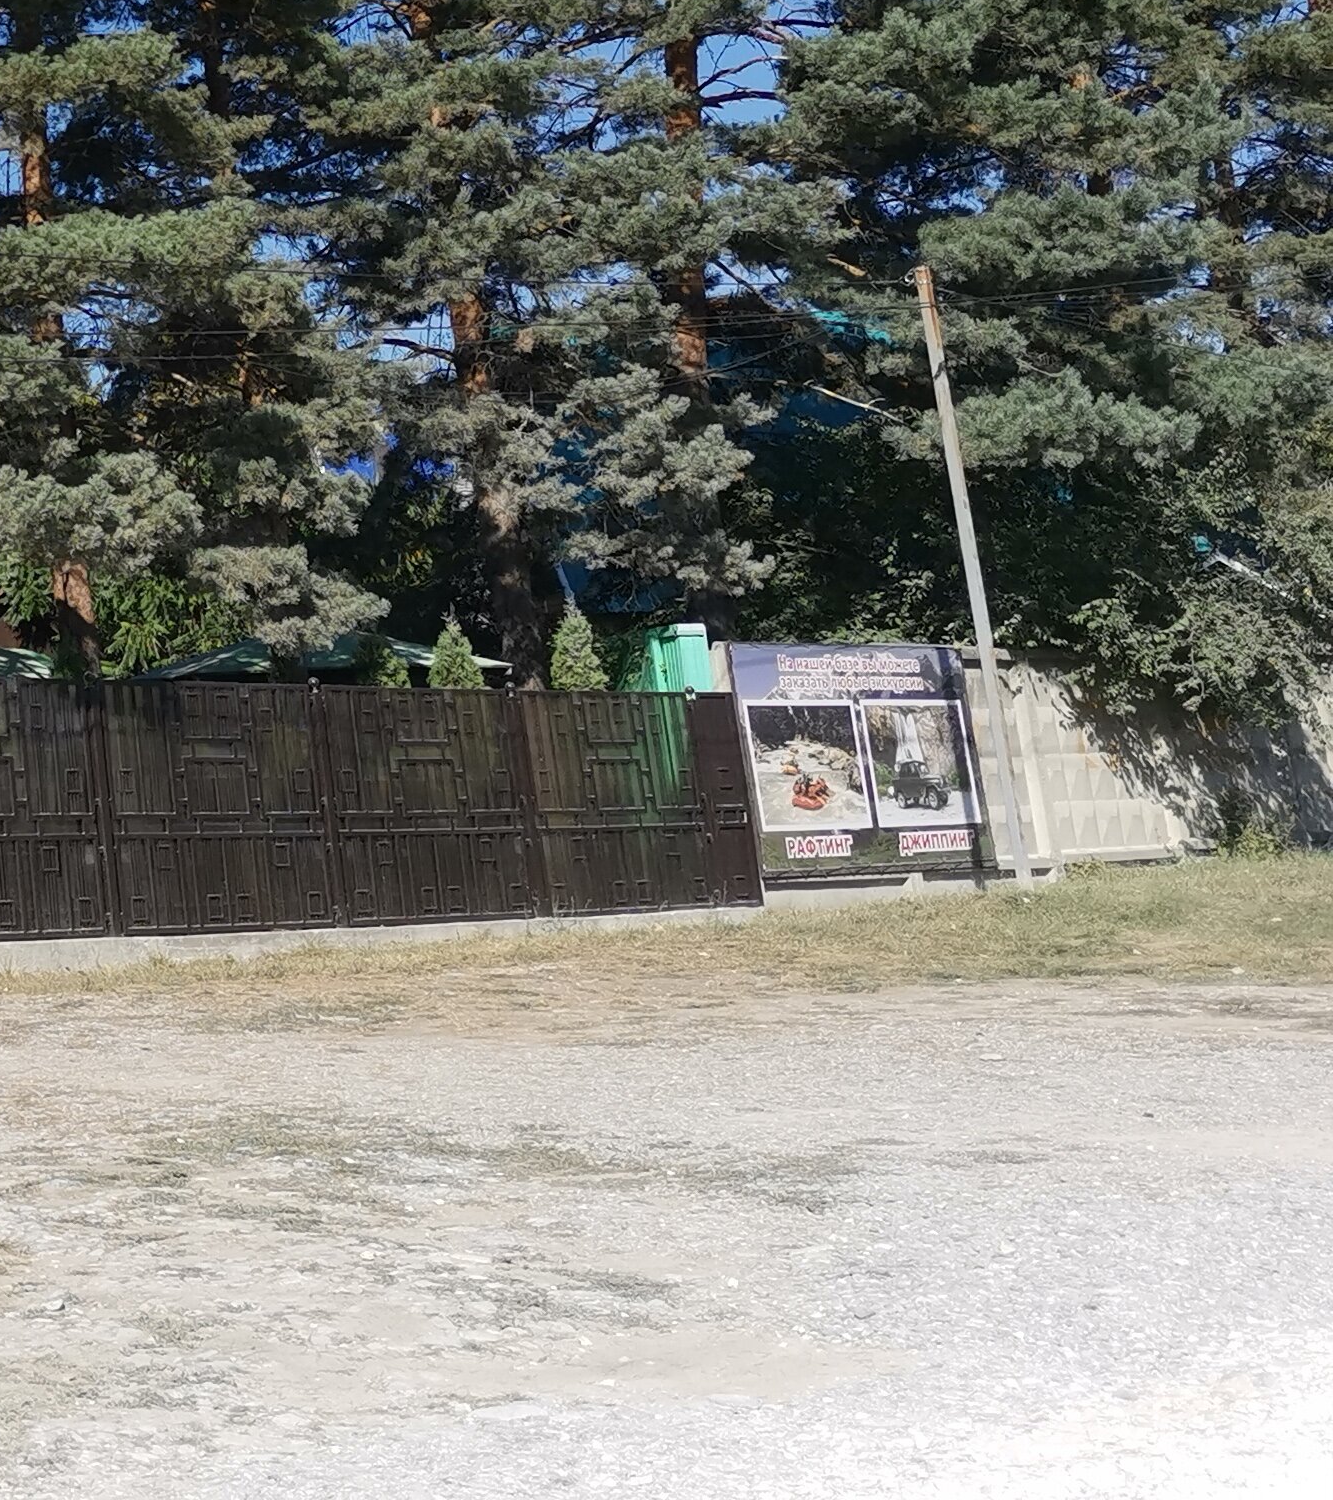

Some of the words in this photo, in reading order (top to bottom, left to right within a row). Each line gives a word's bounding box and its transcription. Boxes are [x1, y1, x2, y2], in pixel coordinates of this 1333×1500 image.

[778, 655, 794, 670] На
[796, 654, 832, 670] нашей
[834, 655, 859, 671] базе
[861, 659, 877, 671] вы
[779, 676, 829, 690] заказать
[831, 674, 868, 690] любые
[869, 676, 924, 692] экскурсии
[787, 836, 852, 857] РАФТИНГ
[900, 831, 974, 855] ДЖИППИНГ
